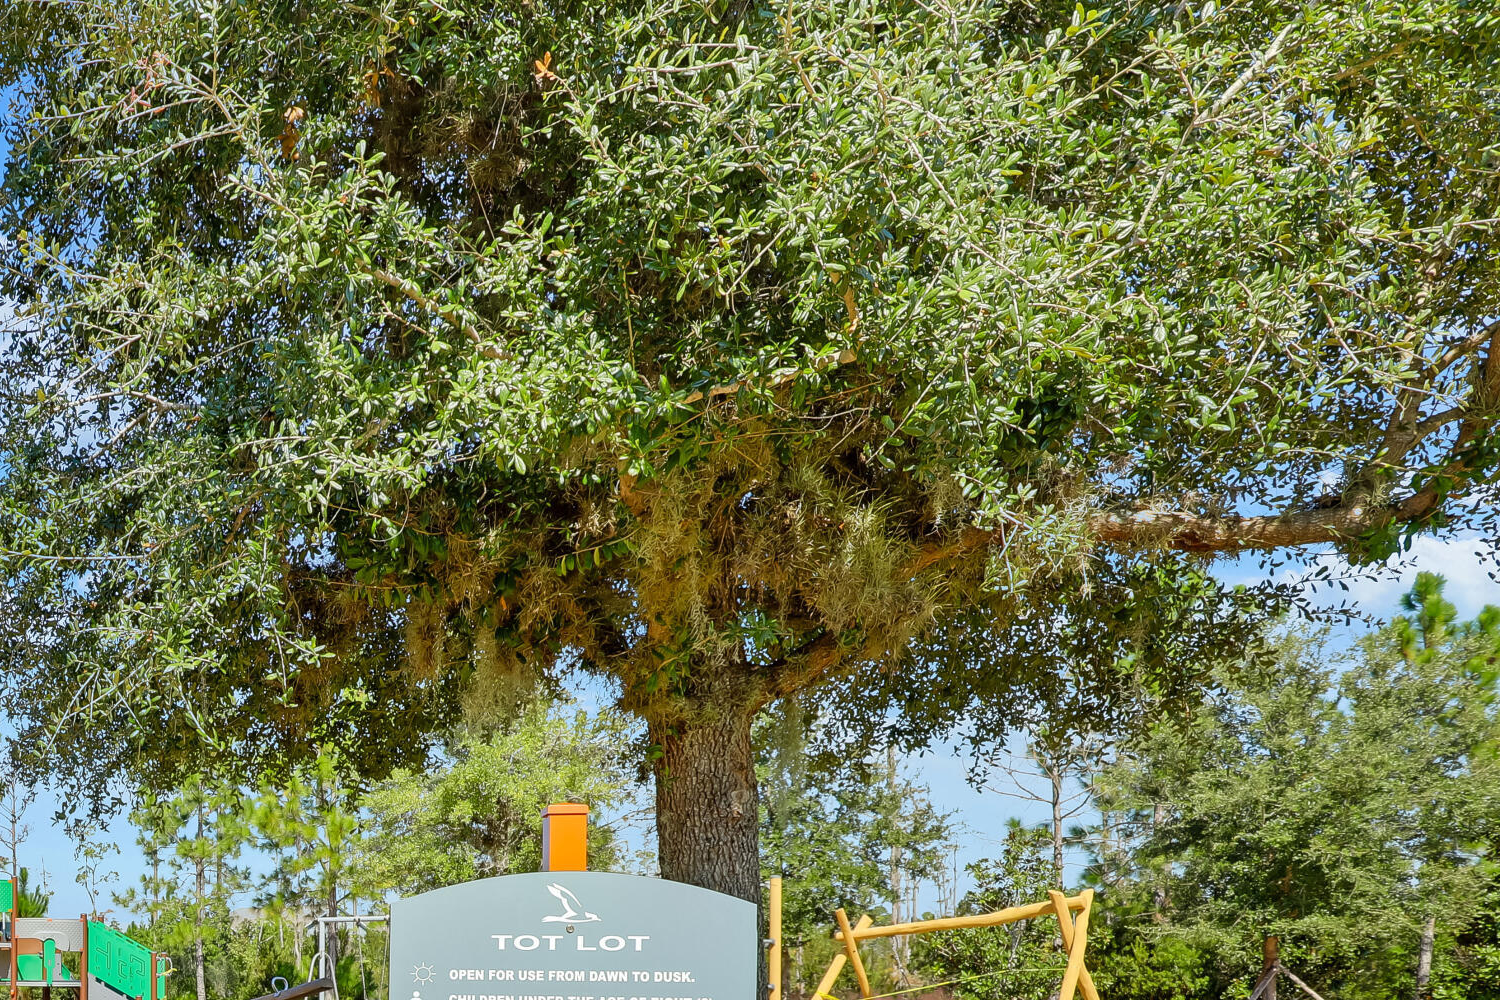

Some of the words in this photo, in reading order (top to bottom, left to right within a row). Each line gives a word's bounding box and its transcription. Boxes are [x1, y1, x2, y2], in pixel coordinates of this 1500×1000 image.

[490, 934, 564, 951] TOT
[576, 935, 651, 952] LOT
[448, 969, 485, 981] OPEN
[488, 969, 515, 981] FOR
[518, 969, 545, 982] USE
[548, 970, 586, 982] FROM
[589, 970, 628, 983] DAWN
[631, 971, 650, 983] TO
[653, 971, 696, 983] DUSK.
